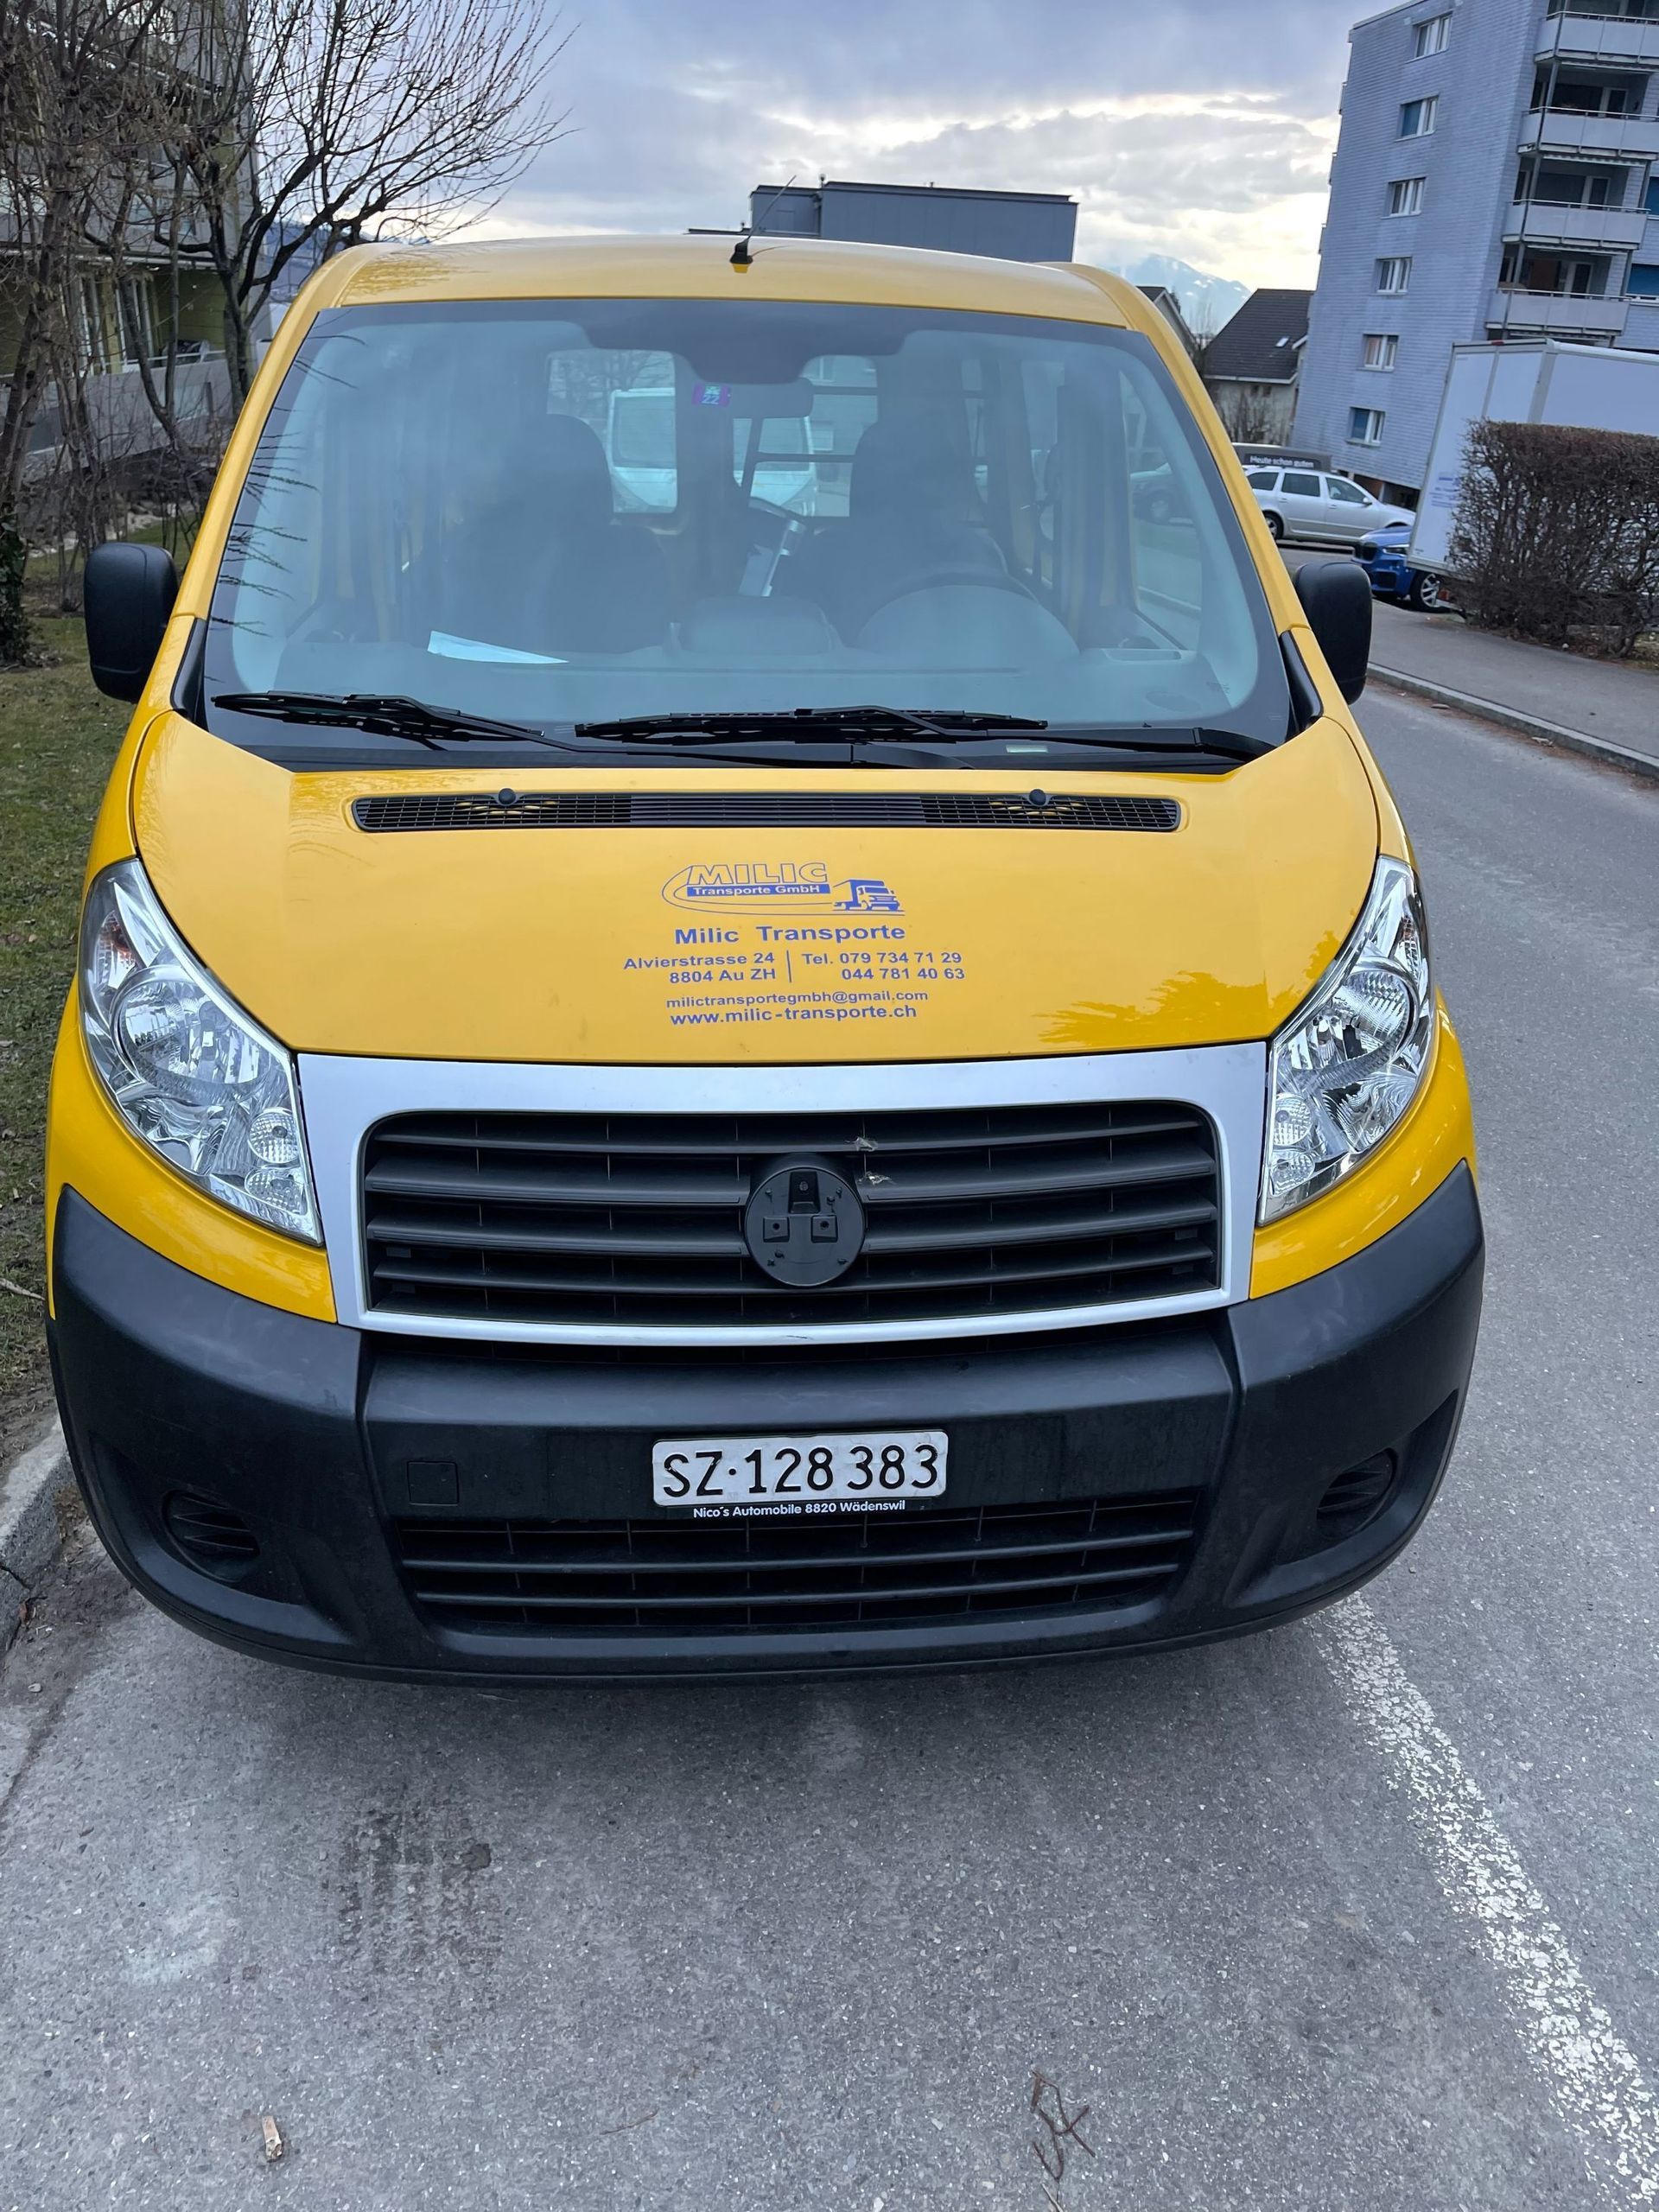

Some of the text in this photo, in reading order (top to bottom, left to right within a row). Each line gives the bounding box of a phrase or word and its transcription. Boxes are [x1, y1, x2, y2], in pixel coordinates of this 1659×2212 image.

[686, 862, 828, 885] MILIC
[692, 885, 820, 896] Transporte GmbH
[674, 925, 906, 944] Milic Transporte
[623, 952, 775, 969] Alvierstrasse 24
[802, 951, 962, 964] Tel. 079 734 71 29
[669, 968, 776, 984] 8804 Au ZH
[841, 967, 965, 981] 044 781 40 63
[666, 990, 928, 1008] milictransportegmbh@gmail.com
[671, 1005, 917, 1026] www.milic-transporte.ch
[732, 1503, 802, 1517] Automobile
[804, 1502, 836, 1514] 8820
[839, 1499, 906, 1513] Wädenswil
